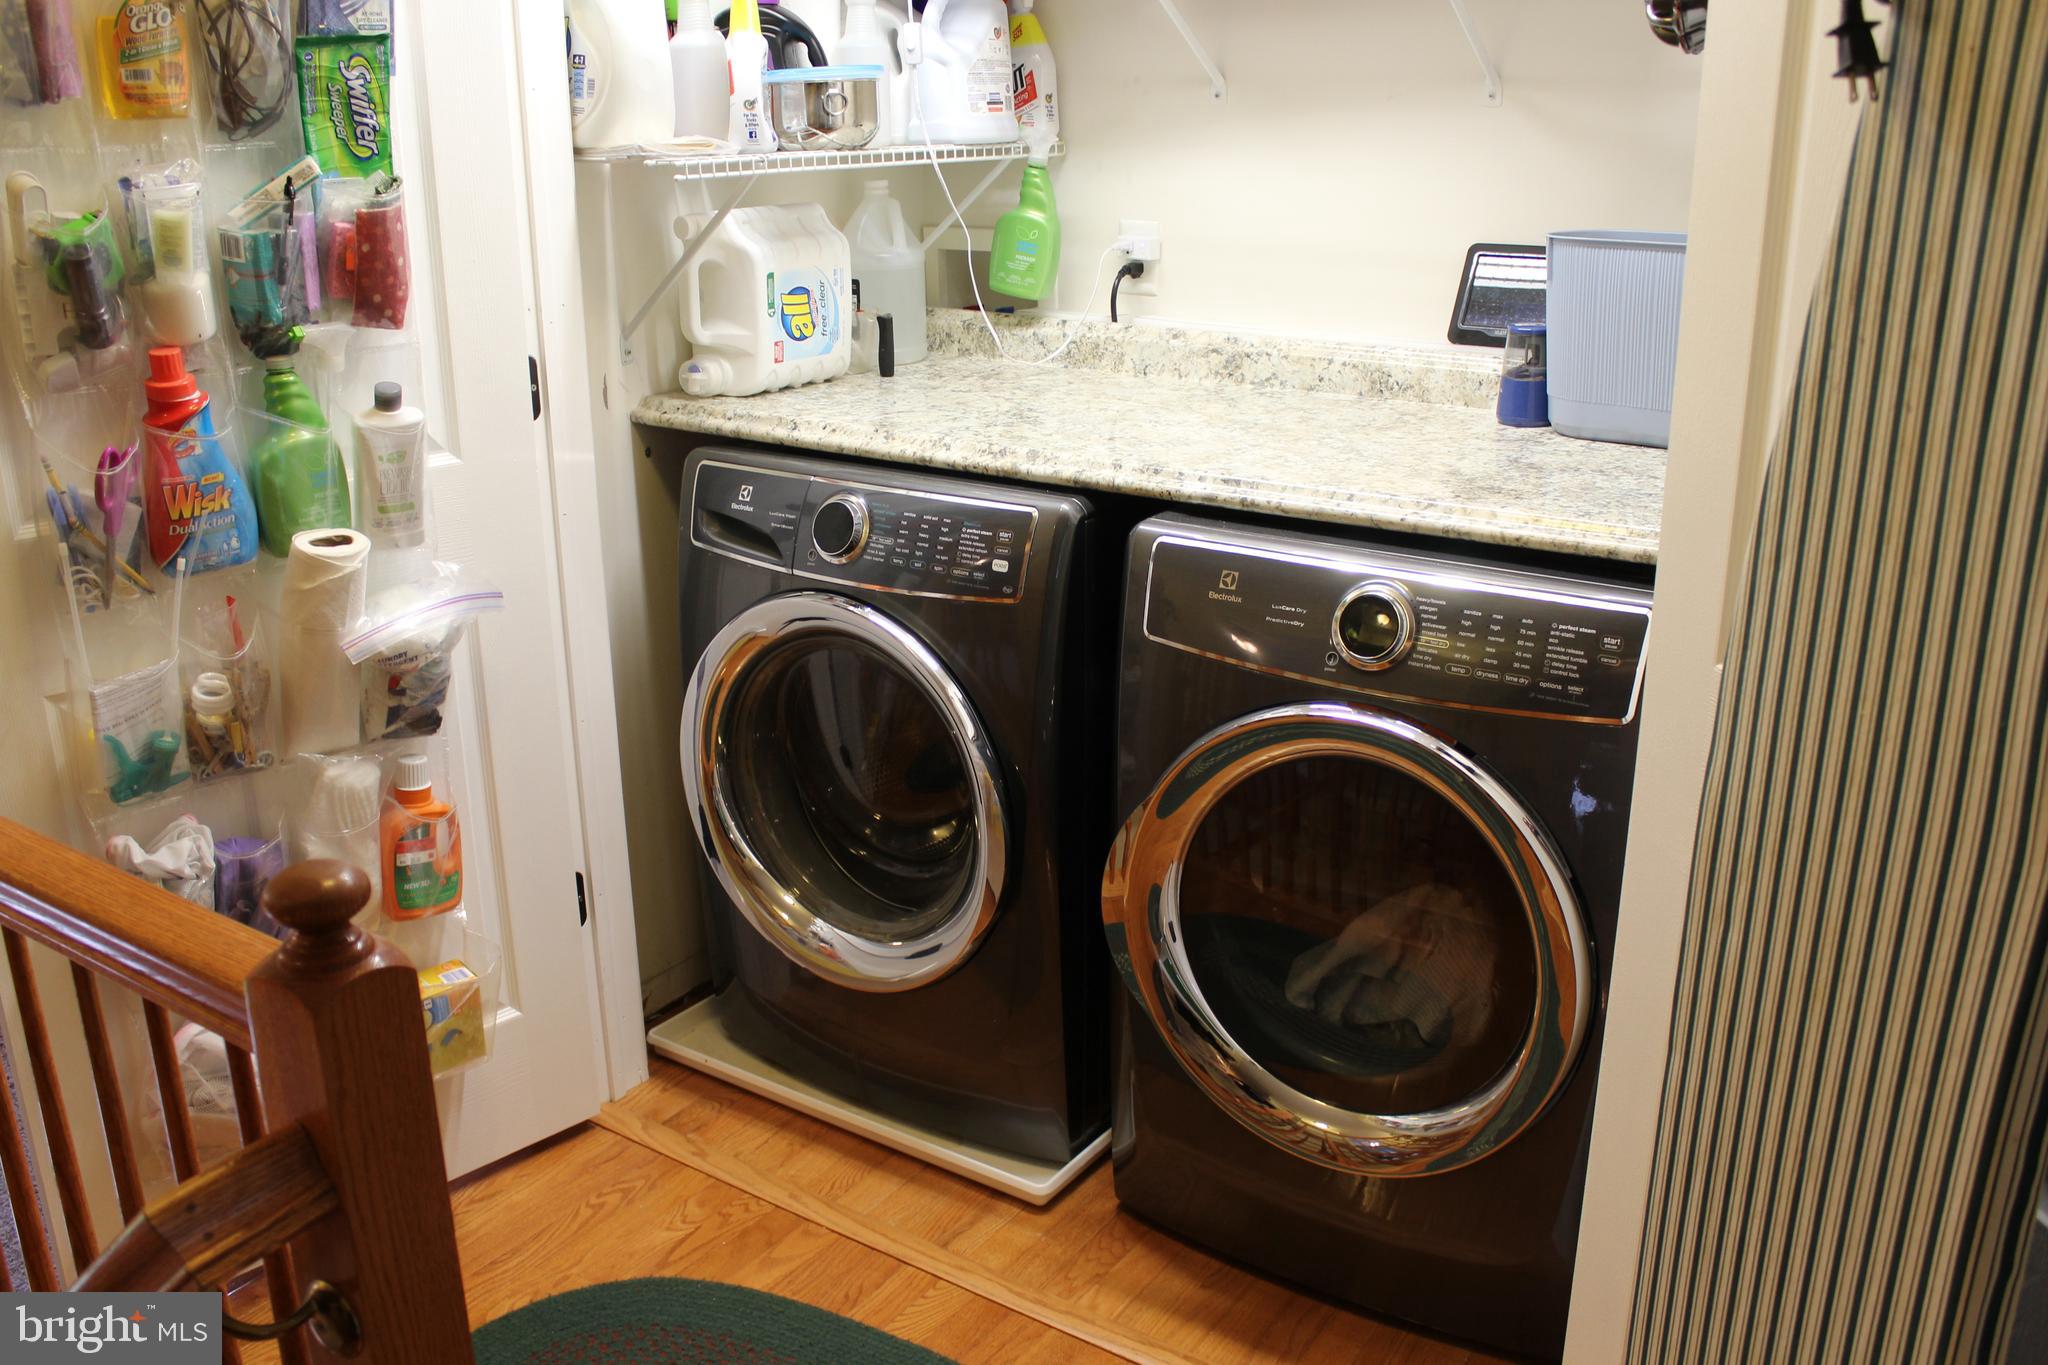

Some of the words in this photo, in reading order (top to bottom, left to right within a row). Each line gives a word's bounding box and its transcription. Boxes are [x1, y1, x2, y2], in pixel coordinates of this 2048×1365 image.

[130, 7, 172, 33] GLO
[327, 82, 349, 142] Sweeper
[338, 60, 379, 156] Swiffer
[818, 280, 826, 309] clear
[781, 293, 814, 338] all
[820, 315, 828, 337] free
[162, 482, 232, 521] Wisk
[731, 502, 754, 512] Electrolux
[169, 520, 199, 536] Dual
[1208, 590, 1242, 604] Electrolux
[1272, 604, 1296, 612] LuxCare
[1266, 616, 1304, 628] PredictiveDry
[1422, 622, 1447, 630] activewear
[1490, 624, 1501, 632] high
[1558, 624, 1578, 632] perfect
[1550, 630, 1576, 638] anti-static
[1603, 636, 1621, 646] start
[1566, 648, 1584, 656] release
[1546, 652, 1570, 660] extended
[1570, 656, 1588, 664] tumble
[1452, 666, 1466, 674] temp
[1476, 670, 1498, 679] dryness
[1550, 668, 1568, 676] control
[1518, 677, 1528, 686] dry
[1539, 680, 1562, 690] options
